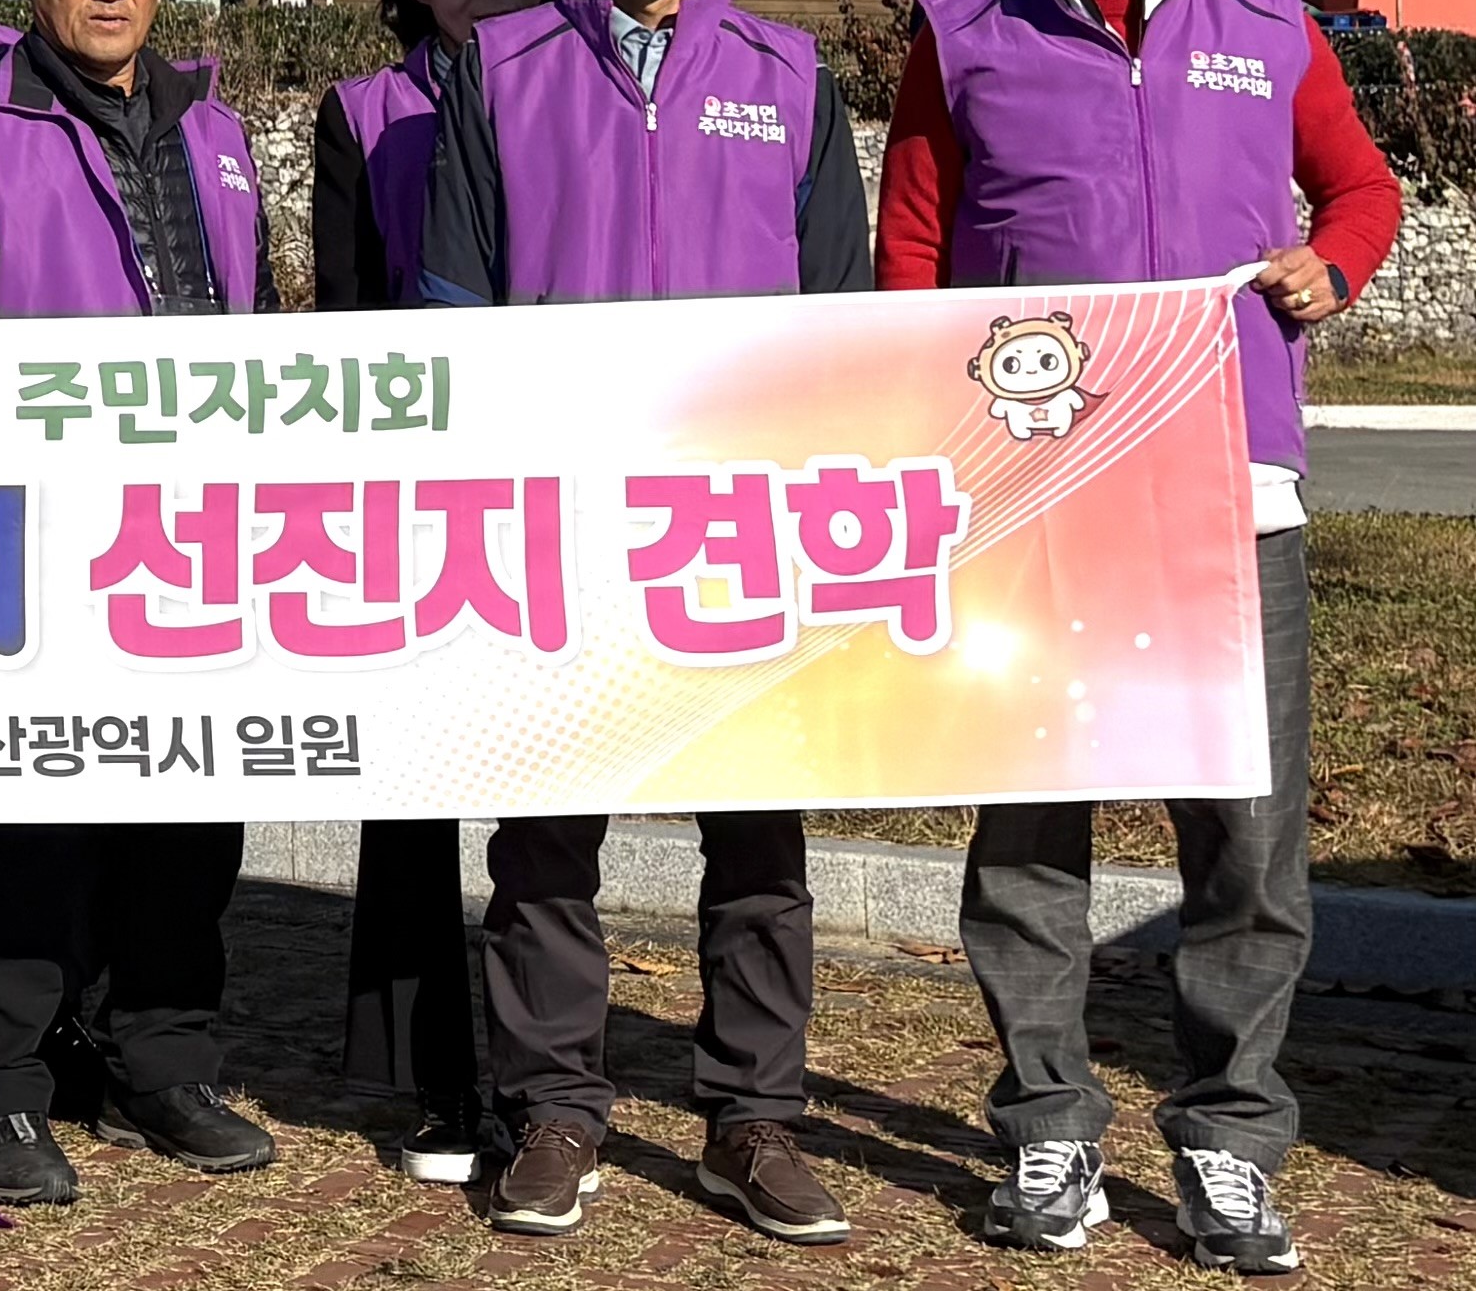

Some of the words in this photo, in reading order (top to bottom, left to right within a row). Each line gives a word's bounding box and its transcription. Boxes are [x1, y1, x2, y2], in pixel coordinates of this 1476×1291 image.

[1211, 52, 1266, 78] 초계면
[1187, 69, 1272, 100] 주민자치회
[723, 101, 777, 124] 초계면
[698, 116, 786, 144] 주민자치회
[15, 352, 450, 445] 주민자치회
[88, 476, 568, 659] 선진지
[624, 467, 963, 655] 견학
[235, 714, 362, 777] 일원
